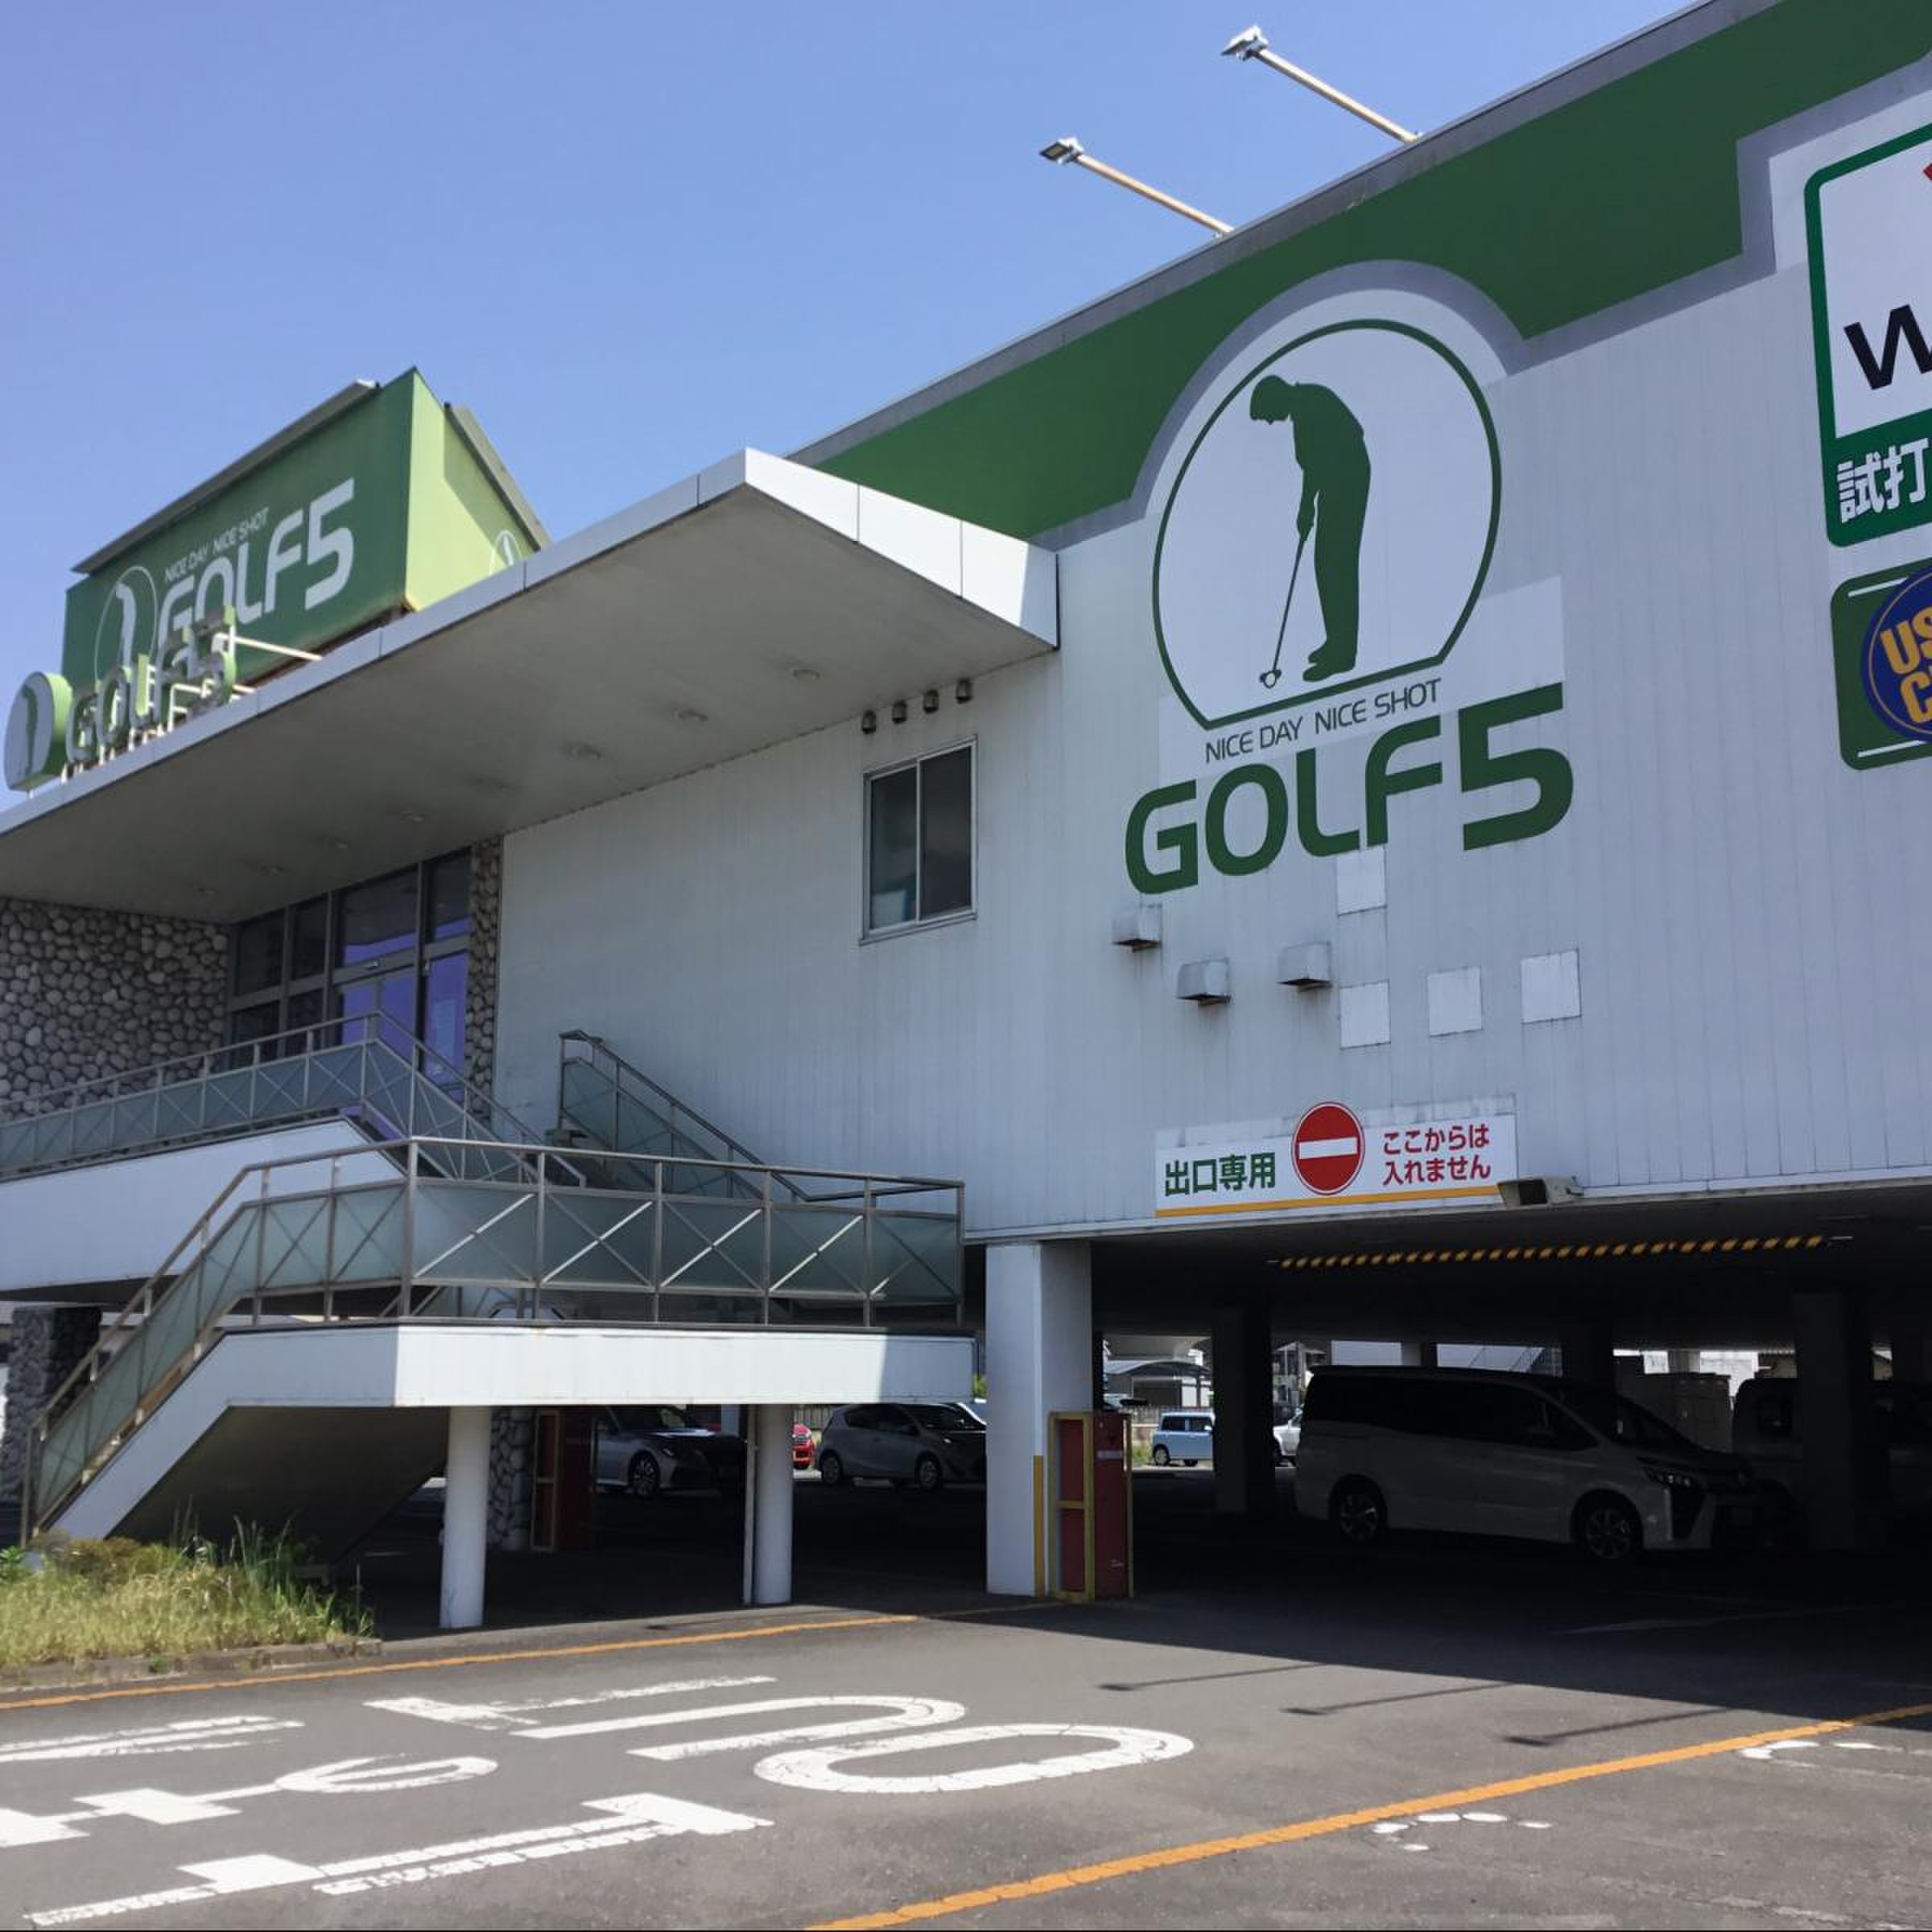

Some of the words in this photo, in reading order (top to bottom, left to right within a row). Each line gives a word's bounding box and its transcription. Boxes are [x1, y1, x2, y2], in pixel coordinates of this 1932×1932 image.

[1836, 438, 1930, 523] 試打
[1205, 730, 1253, 763] NICE
[1260, 716, 1303, 749] DAY
[1315, 699, 1367, 734] NICE
[1374, 678, 1442, 718] SHOT
[1125, 682, 1574, 895] GOLF5
[1164, 1151, 1277, 1197] 出口専用
[1381, 1154, 1492, 1187] 入れません
[1382, 1122, 1491, 1155] ここからは
[365, 1674, 1196, 1796] OUT
